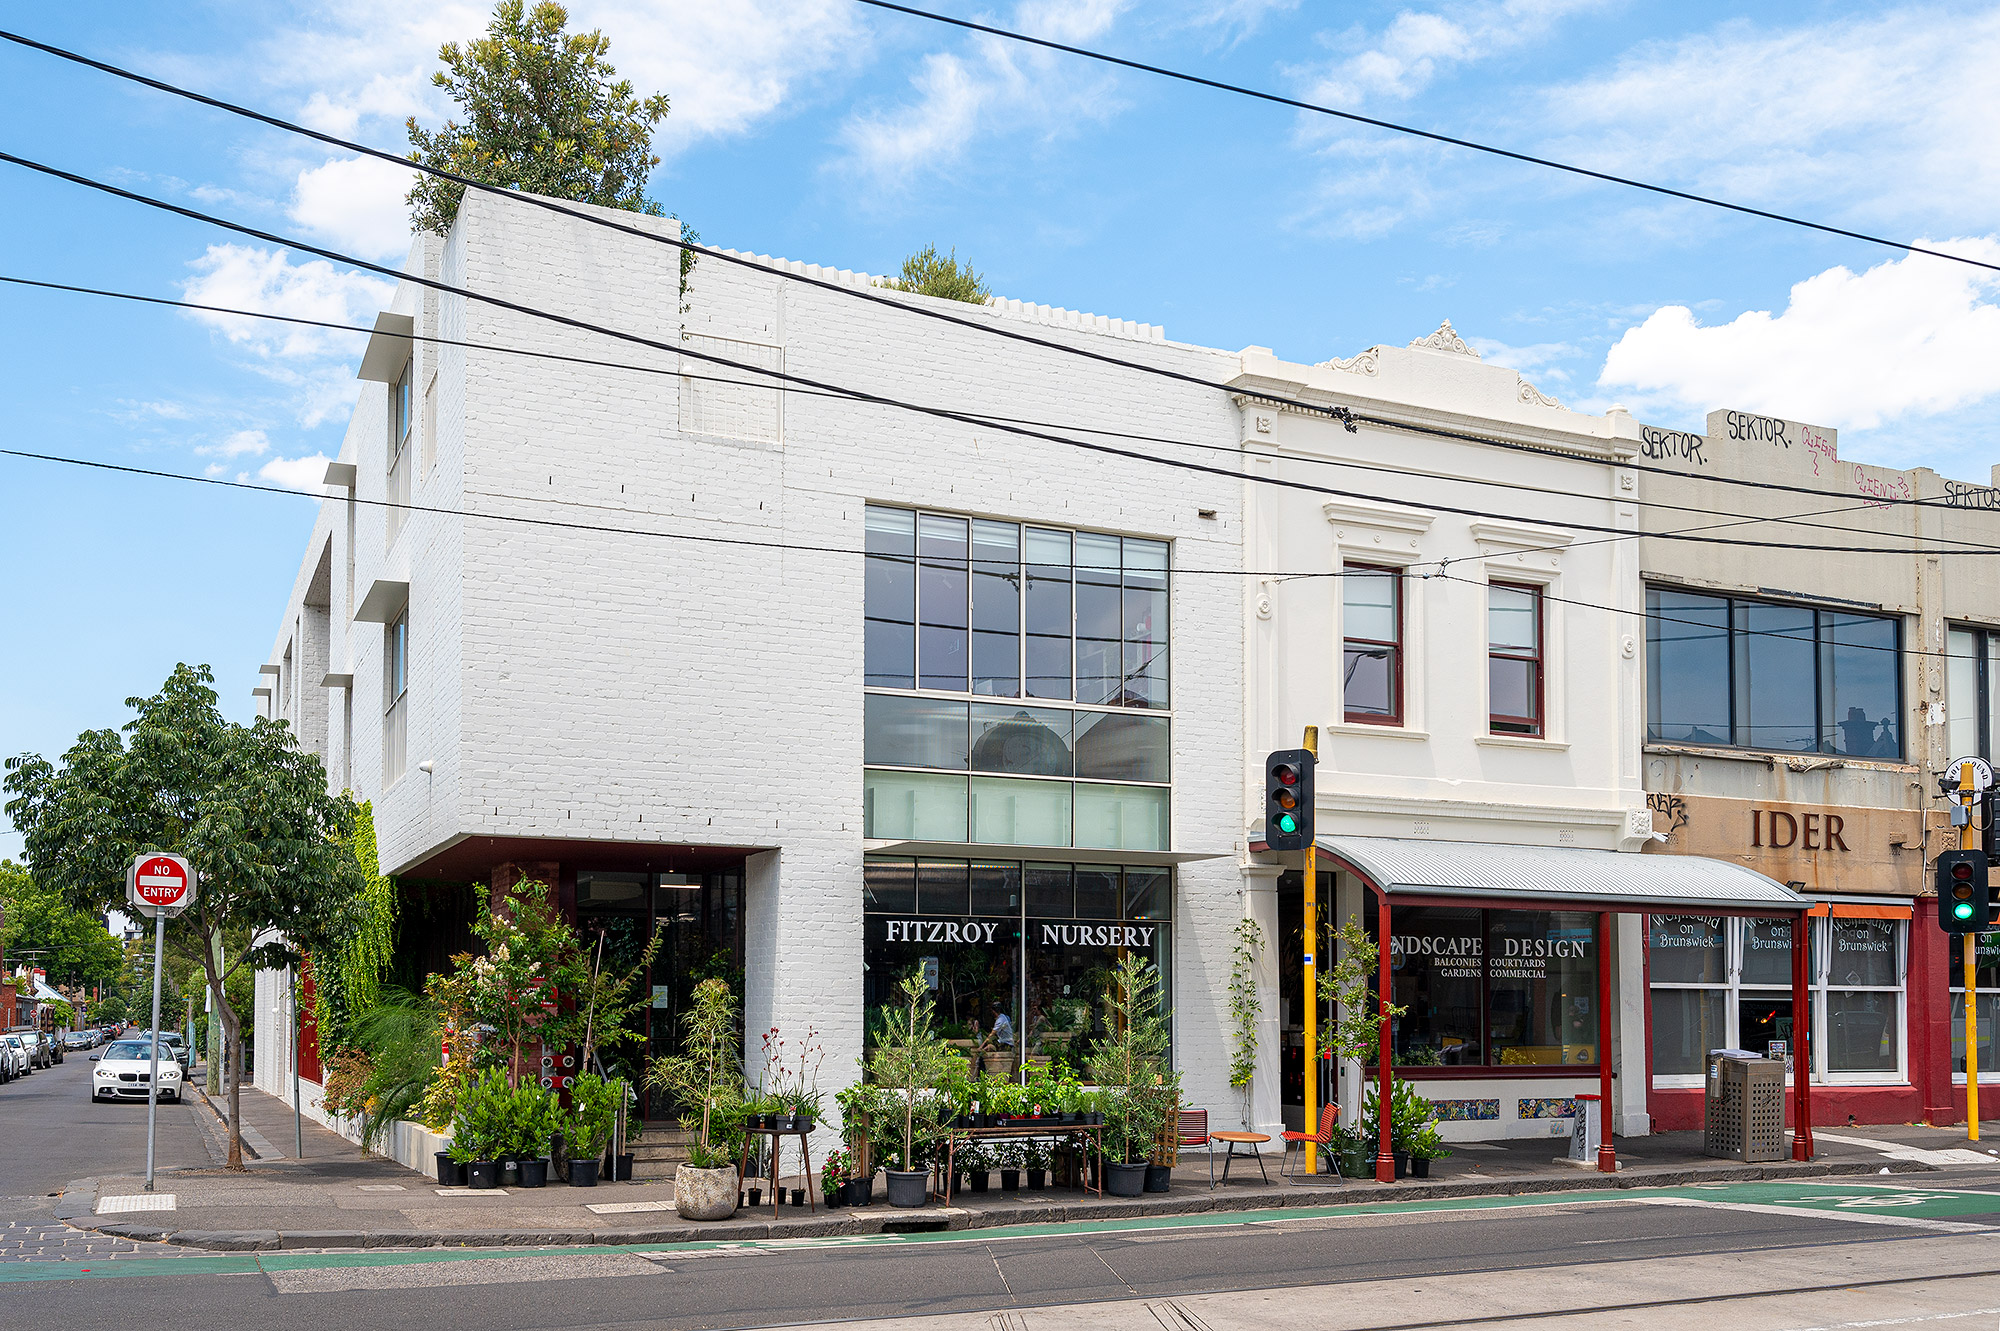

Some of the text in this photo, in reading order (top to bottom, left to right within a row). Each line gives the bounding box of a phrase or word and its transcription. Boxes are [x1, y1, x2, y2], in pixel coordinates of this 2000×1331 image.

[1726, 410, 1793, 449] SEKTOR.
[1751, 809, 1851, 852] IDER
[154, 865, 170, 876] NO
[143, 887, 180, 898] ENTRY
[886, 920, 1155, 947] FITZROY NURSERY
[1679, 924, 1694, 934] on
[1771, 926, 1784, 937] on
[1856, 929, 1869, 939] on
[1659, 933, 1715, 948] Brunswick
[1751, 936, 1792, 950] Brunswi
[1980, 934, 1992, 944] on
[1366, 935, 1586, 958] NDSCAPE DESIGN
[1838, 938, 1888, 952] Brunswick
[1434, 957, 1546, 968] BALCONIES COURTYARDS
[1441, 968, 1547, 979] GARDENS COMMERCIAL
